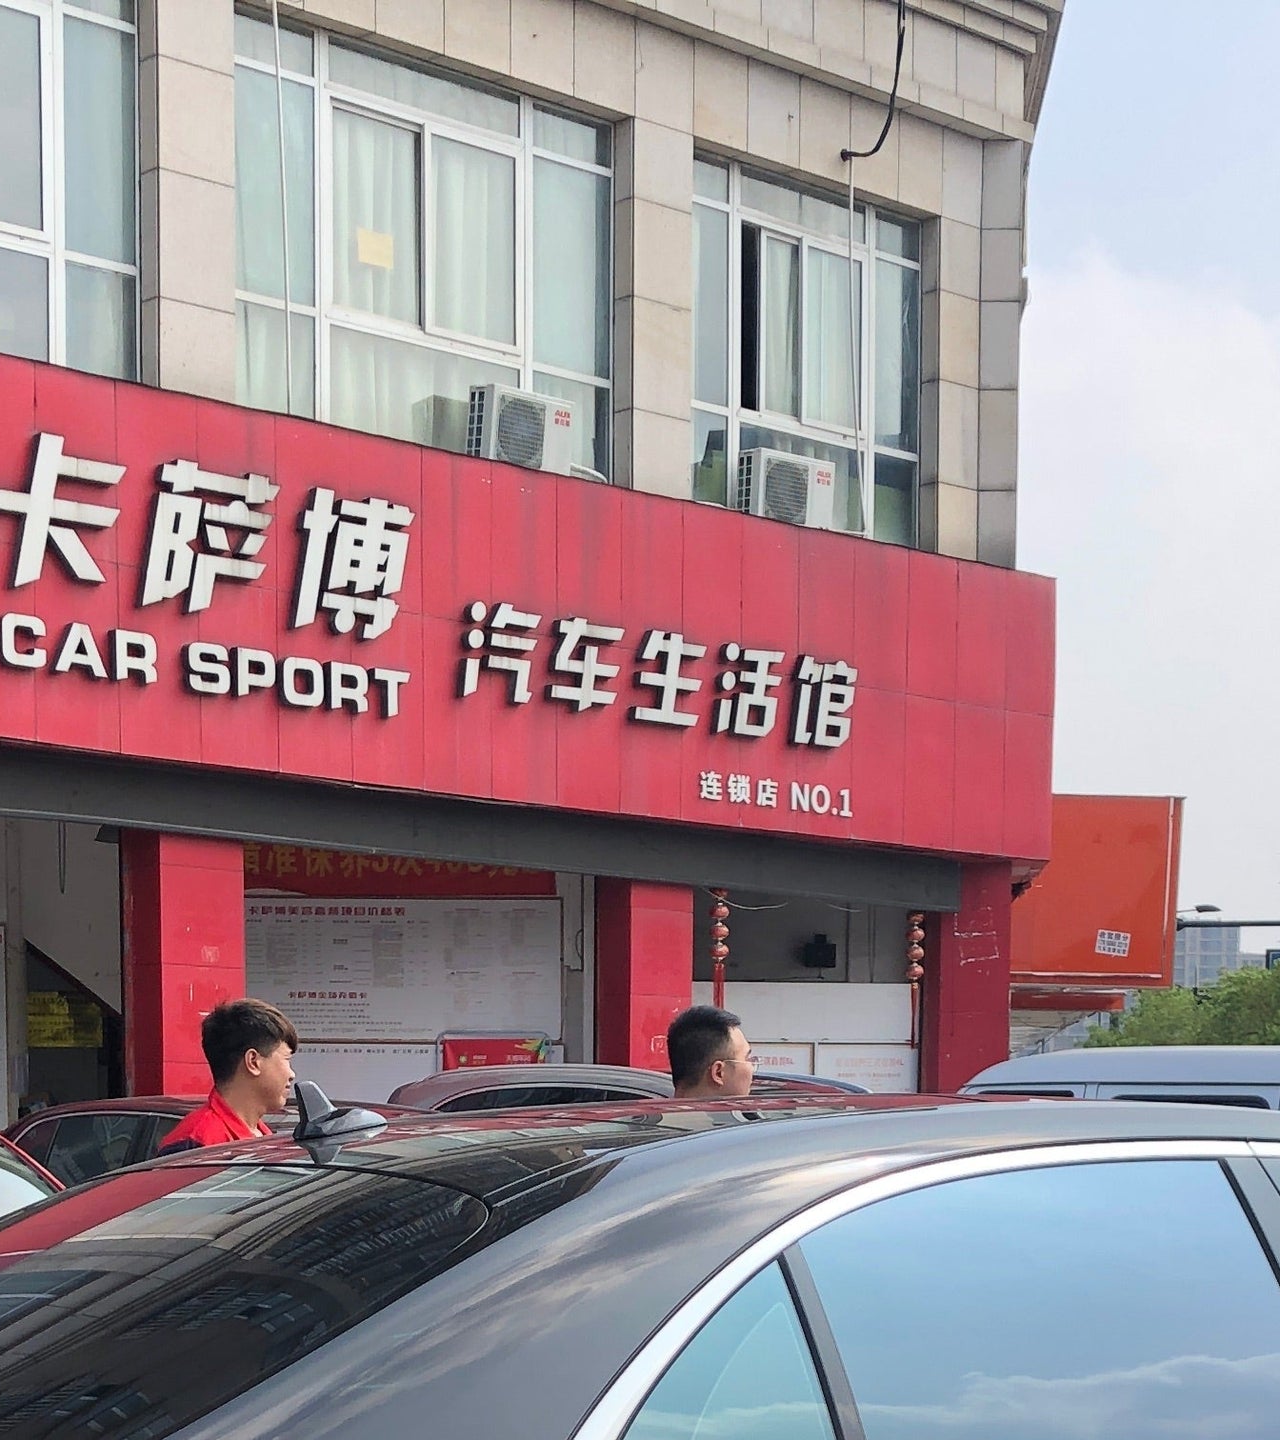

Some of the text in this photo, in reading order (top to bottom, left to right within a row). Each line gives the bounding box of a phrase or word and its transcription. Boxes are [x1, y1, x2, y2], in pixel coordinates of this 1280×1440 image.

[0, 611, 412, 719] CAR SPORT
[460, 599, 858, 751] 汽车生活馆
[699, 770, 854, 819] 连锁店 NO.1
